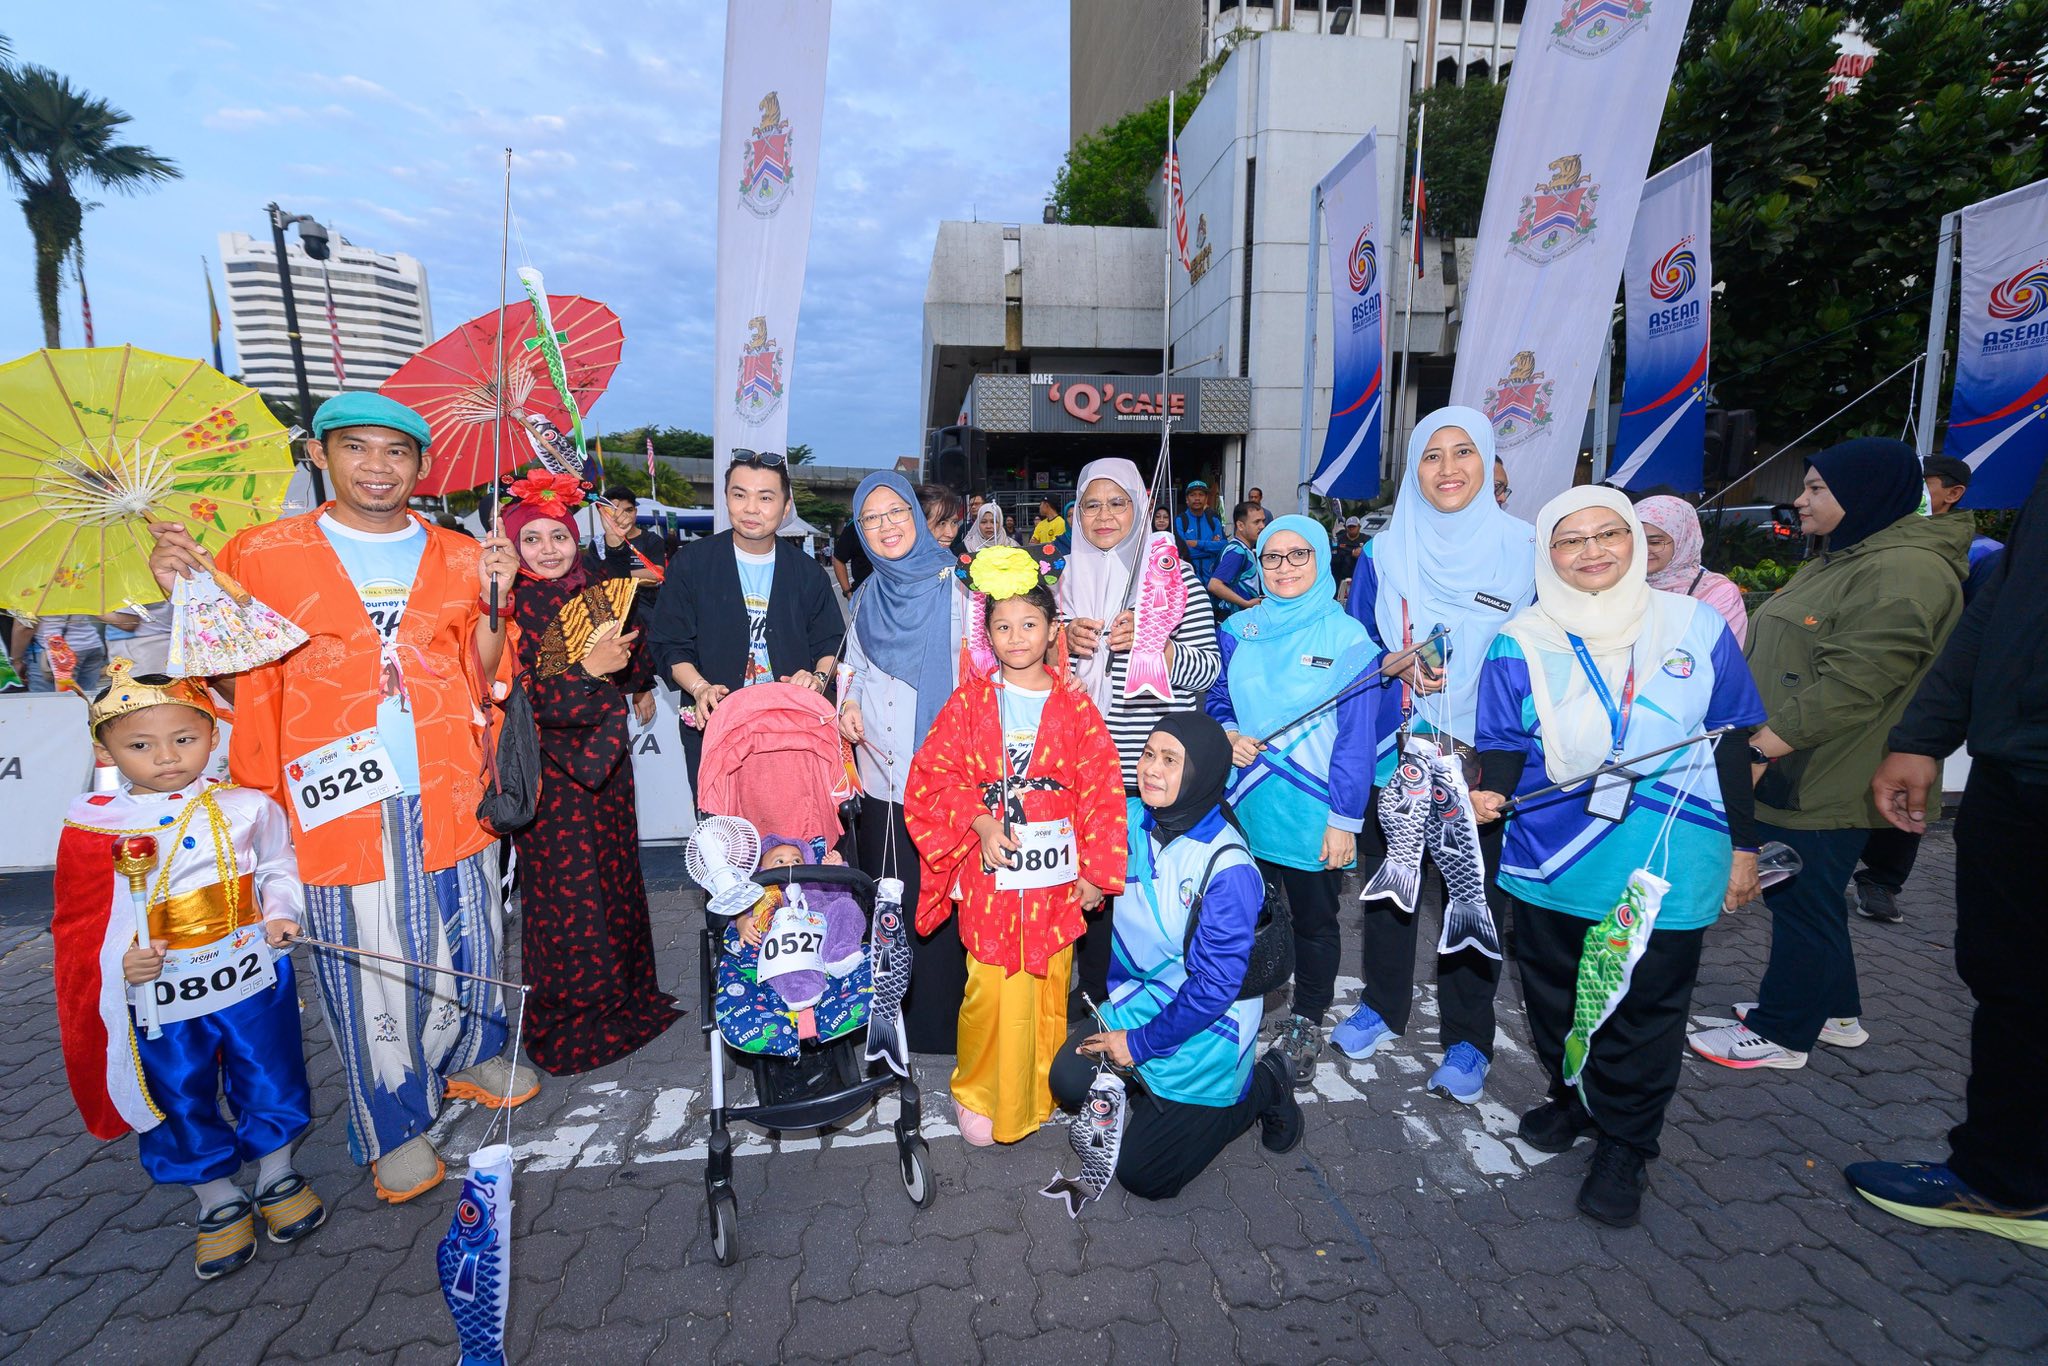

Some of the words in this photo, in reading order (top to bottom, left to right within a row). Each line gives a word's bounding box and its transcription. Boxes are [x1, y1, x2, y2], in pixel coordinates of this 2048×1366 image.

[1352, 293, 1381, 322] ASEAN
[1649, 300, 1699, 328] ASEAN
[1649, 321, 1683, 335] MALAYSIA
[1983, 340, 2028, 352] MALAYSIA
[1031, 374, 1053, 384] KAFE
[302, 760, 383, 809] 0528
[1009, 844, 1069, 872] 0801
[764, 932, 823, 961] 0527
[154, 952, 262, 1006] 0802
[734, 1005, 751, 1018] DINO
[821, 995, 836, 1008] DINO
[830, 1010, 848, 1030] ASTRO
[738, 1026, 760, 1044] ASTRO
